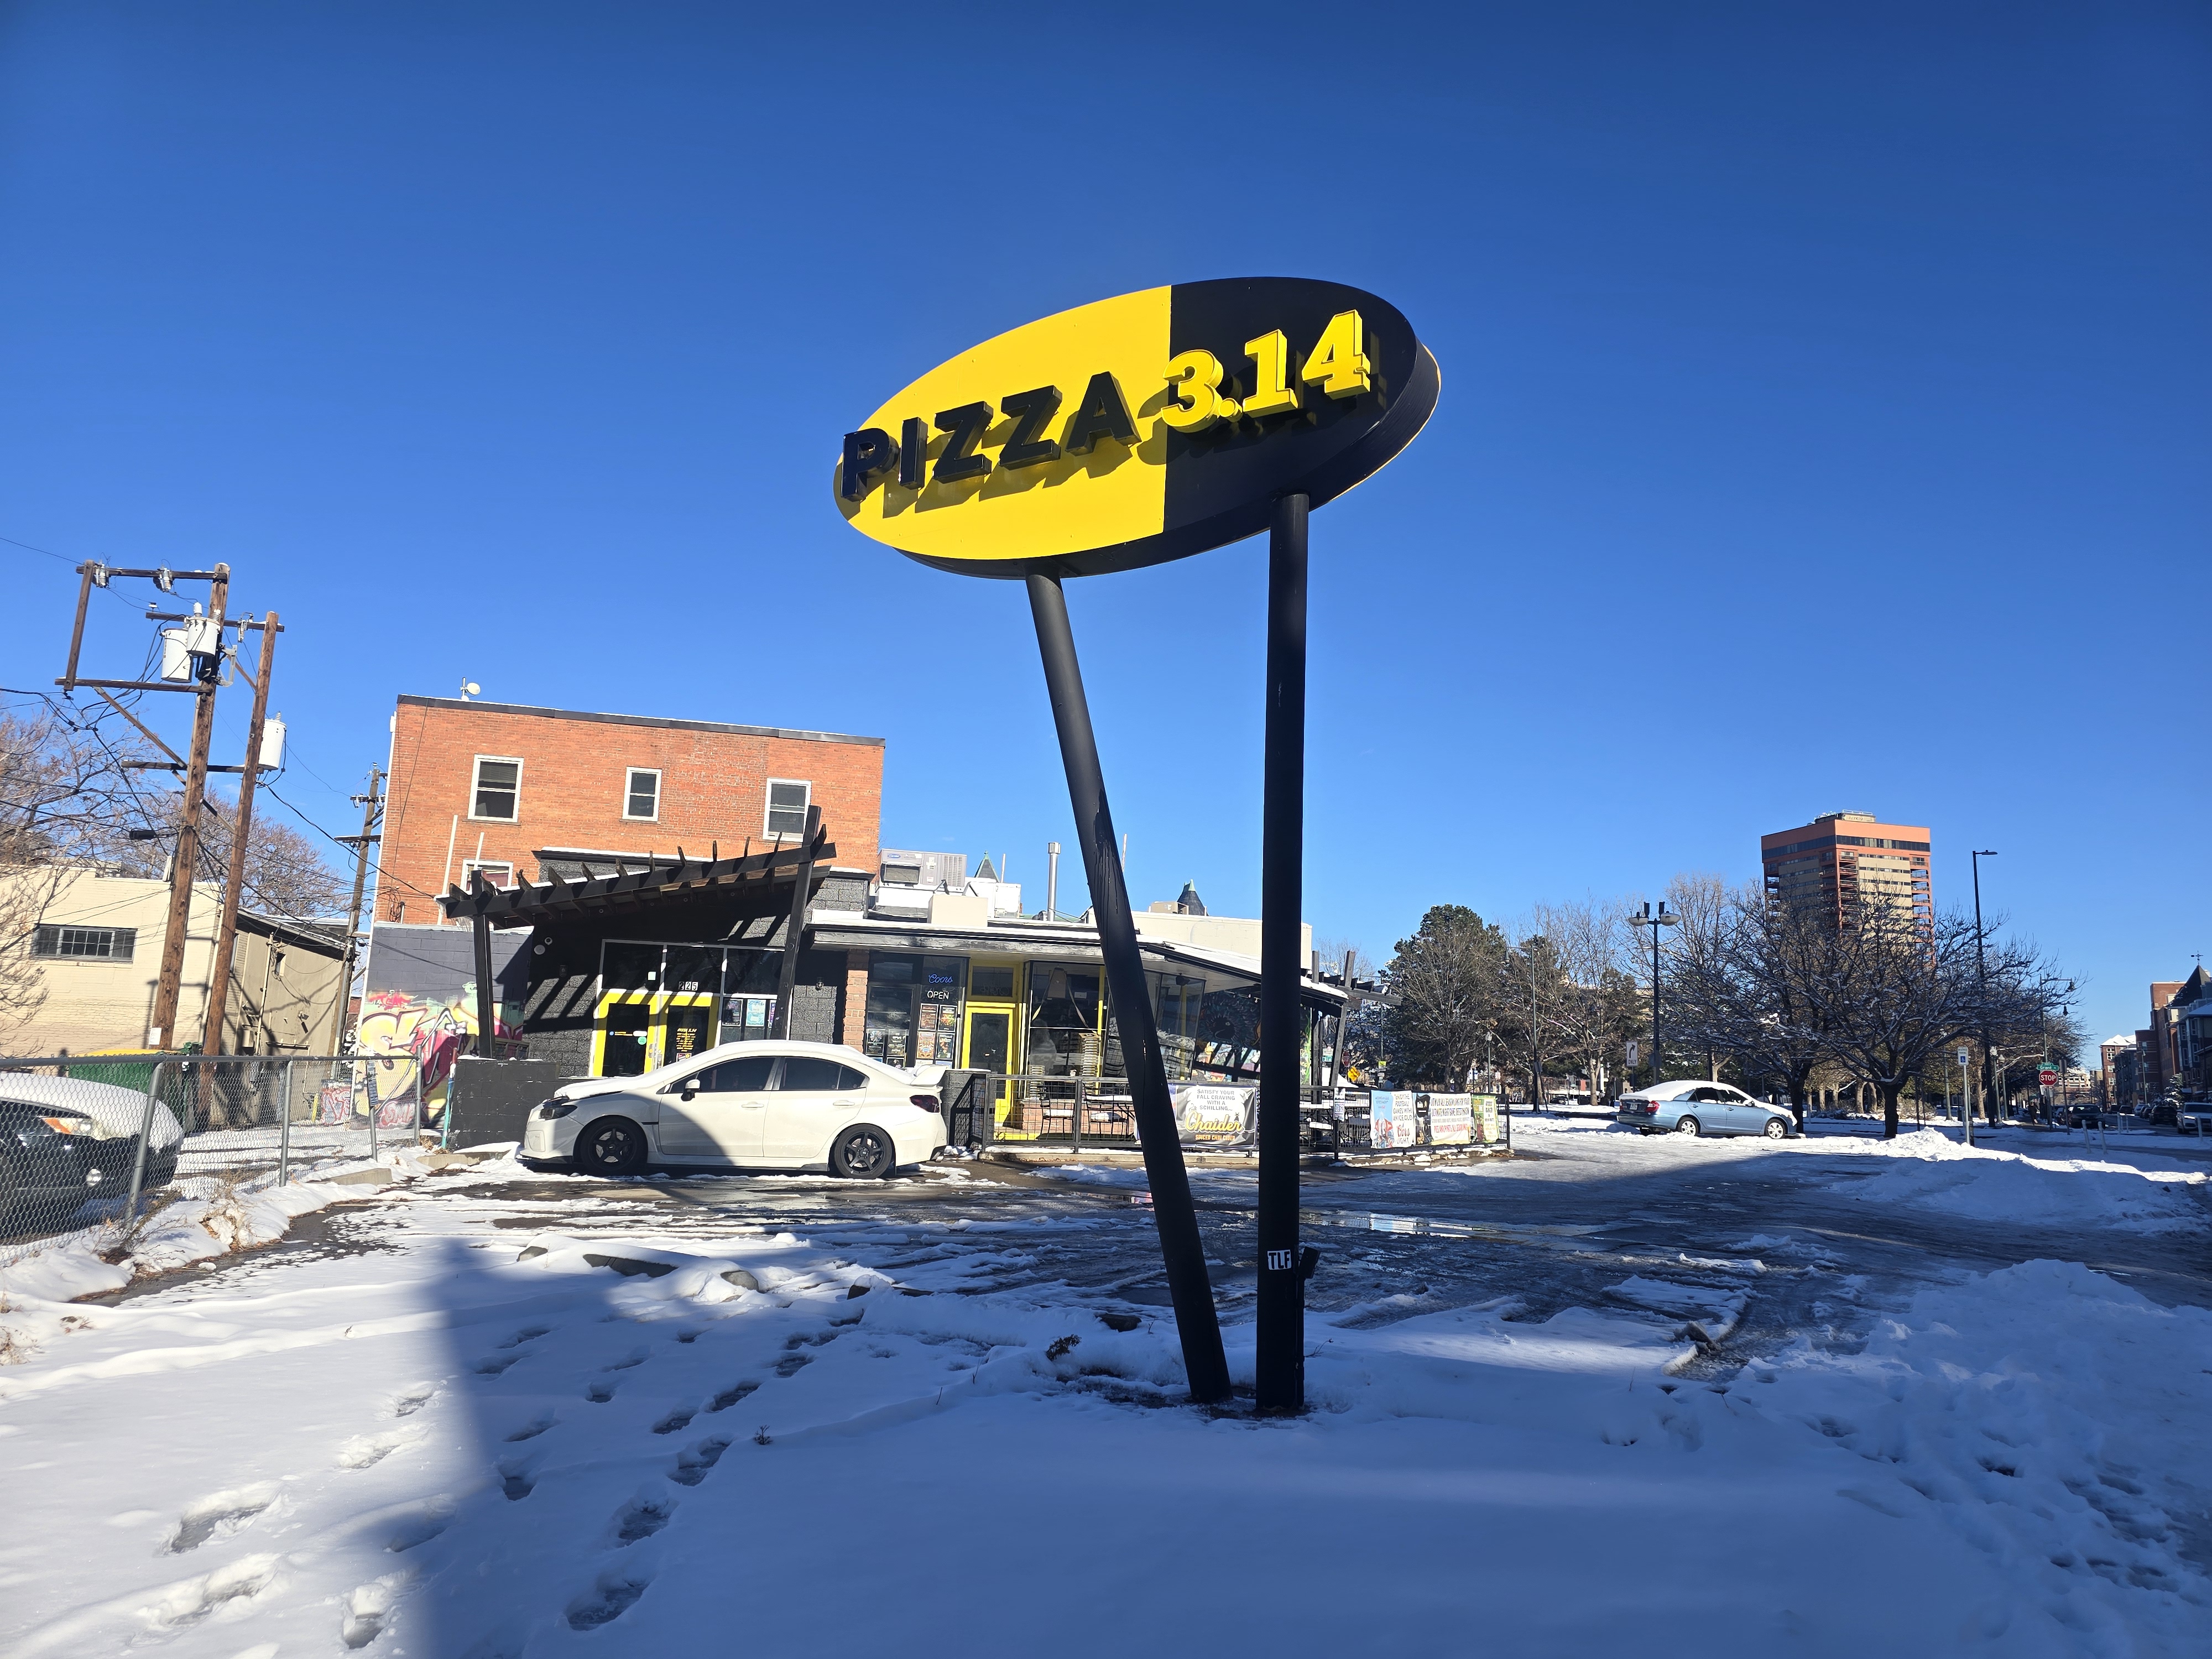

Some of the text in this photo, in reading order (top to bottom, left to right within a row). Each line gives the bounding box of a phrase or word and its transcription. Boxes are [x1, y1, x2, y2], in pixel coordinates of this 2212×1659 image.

[842, 310, 1370, 502] PIZZA 3.14
[928, 974, 953, 983] Coors
[679, 982, 697, 990] 225
[927, 990, 949, 1000] OPEN
[1186, 1110, 1243, 1131] Chaider
[1268, 1251, 1290, 1269] TLF
